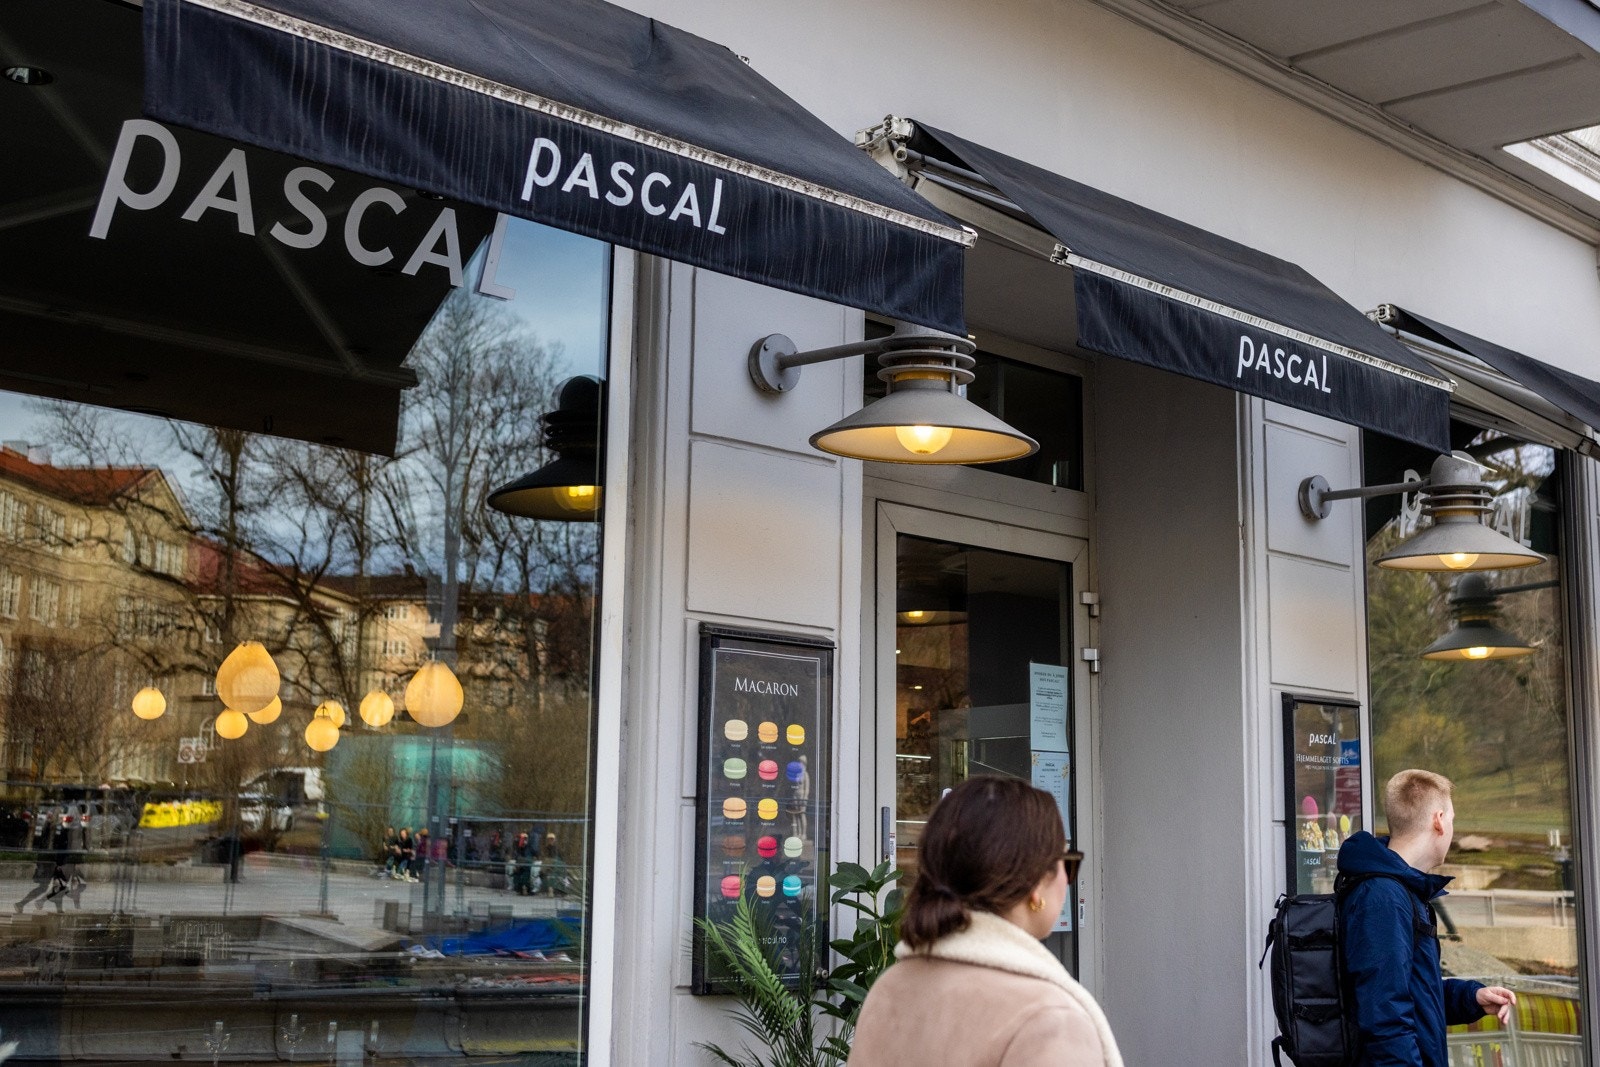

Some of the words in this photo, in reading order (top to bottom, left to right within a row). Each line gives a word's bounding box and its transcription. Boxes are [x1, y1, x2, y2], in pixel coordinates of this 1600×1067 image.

[89, 119, 516, 300] PASCAL
[521, 137, 727, 236] PASCAL
[1236, 335, 1332, 394] PASCAL
[734, 677, 799, 697] MACARON
[1308, 732, 1337, 746] PASCAL
